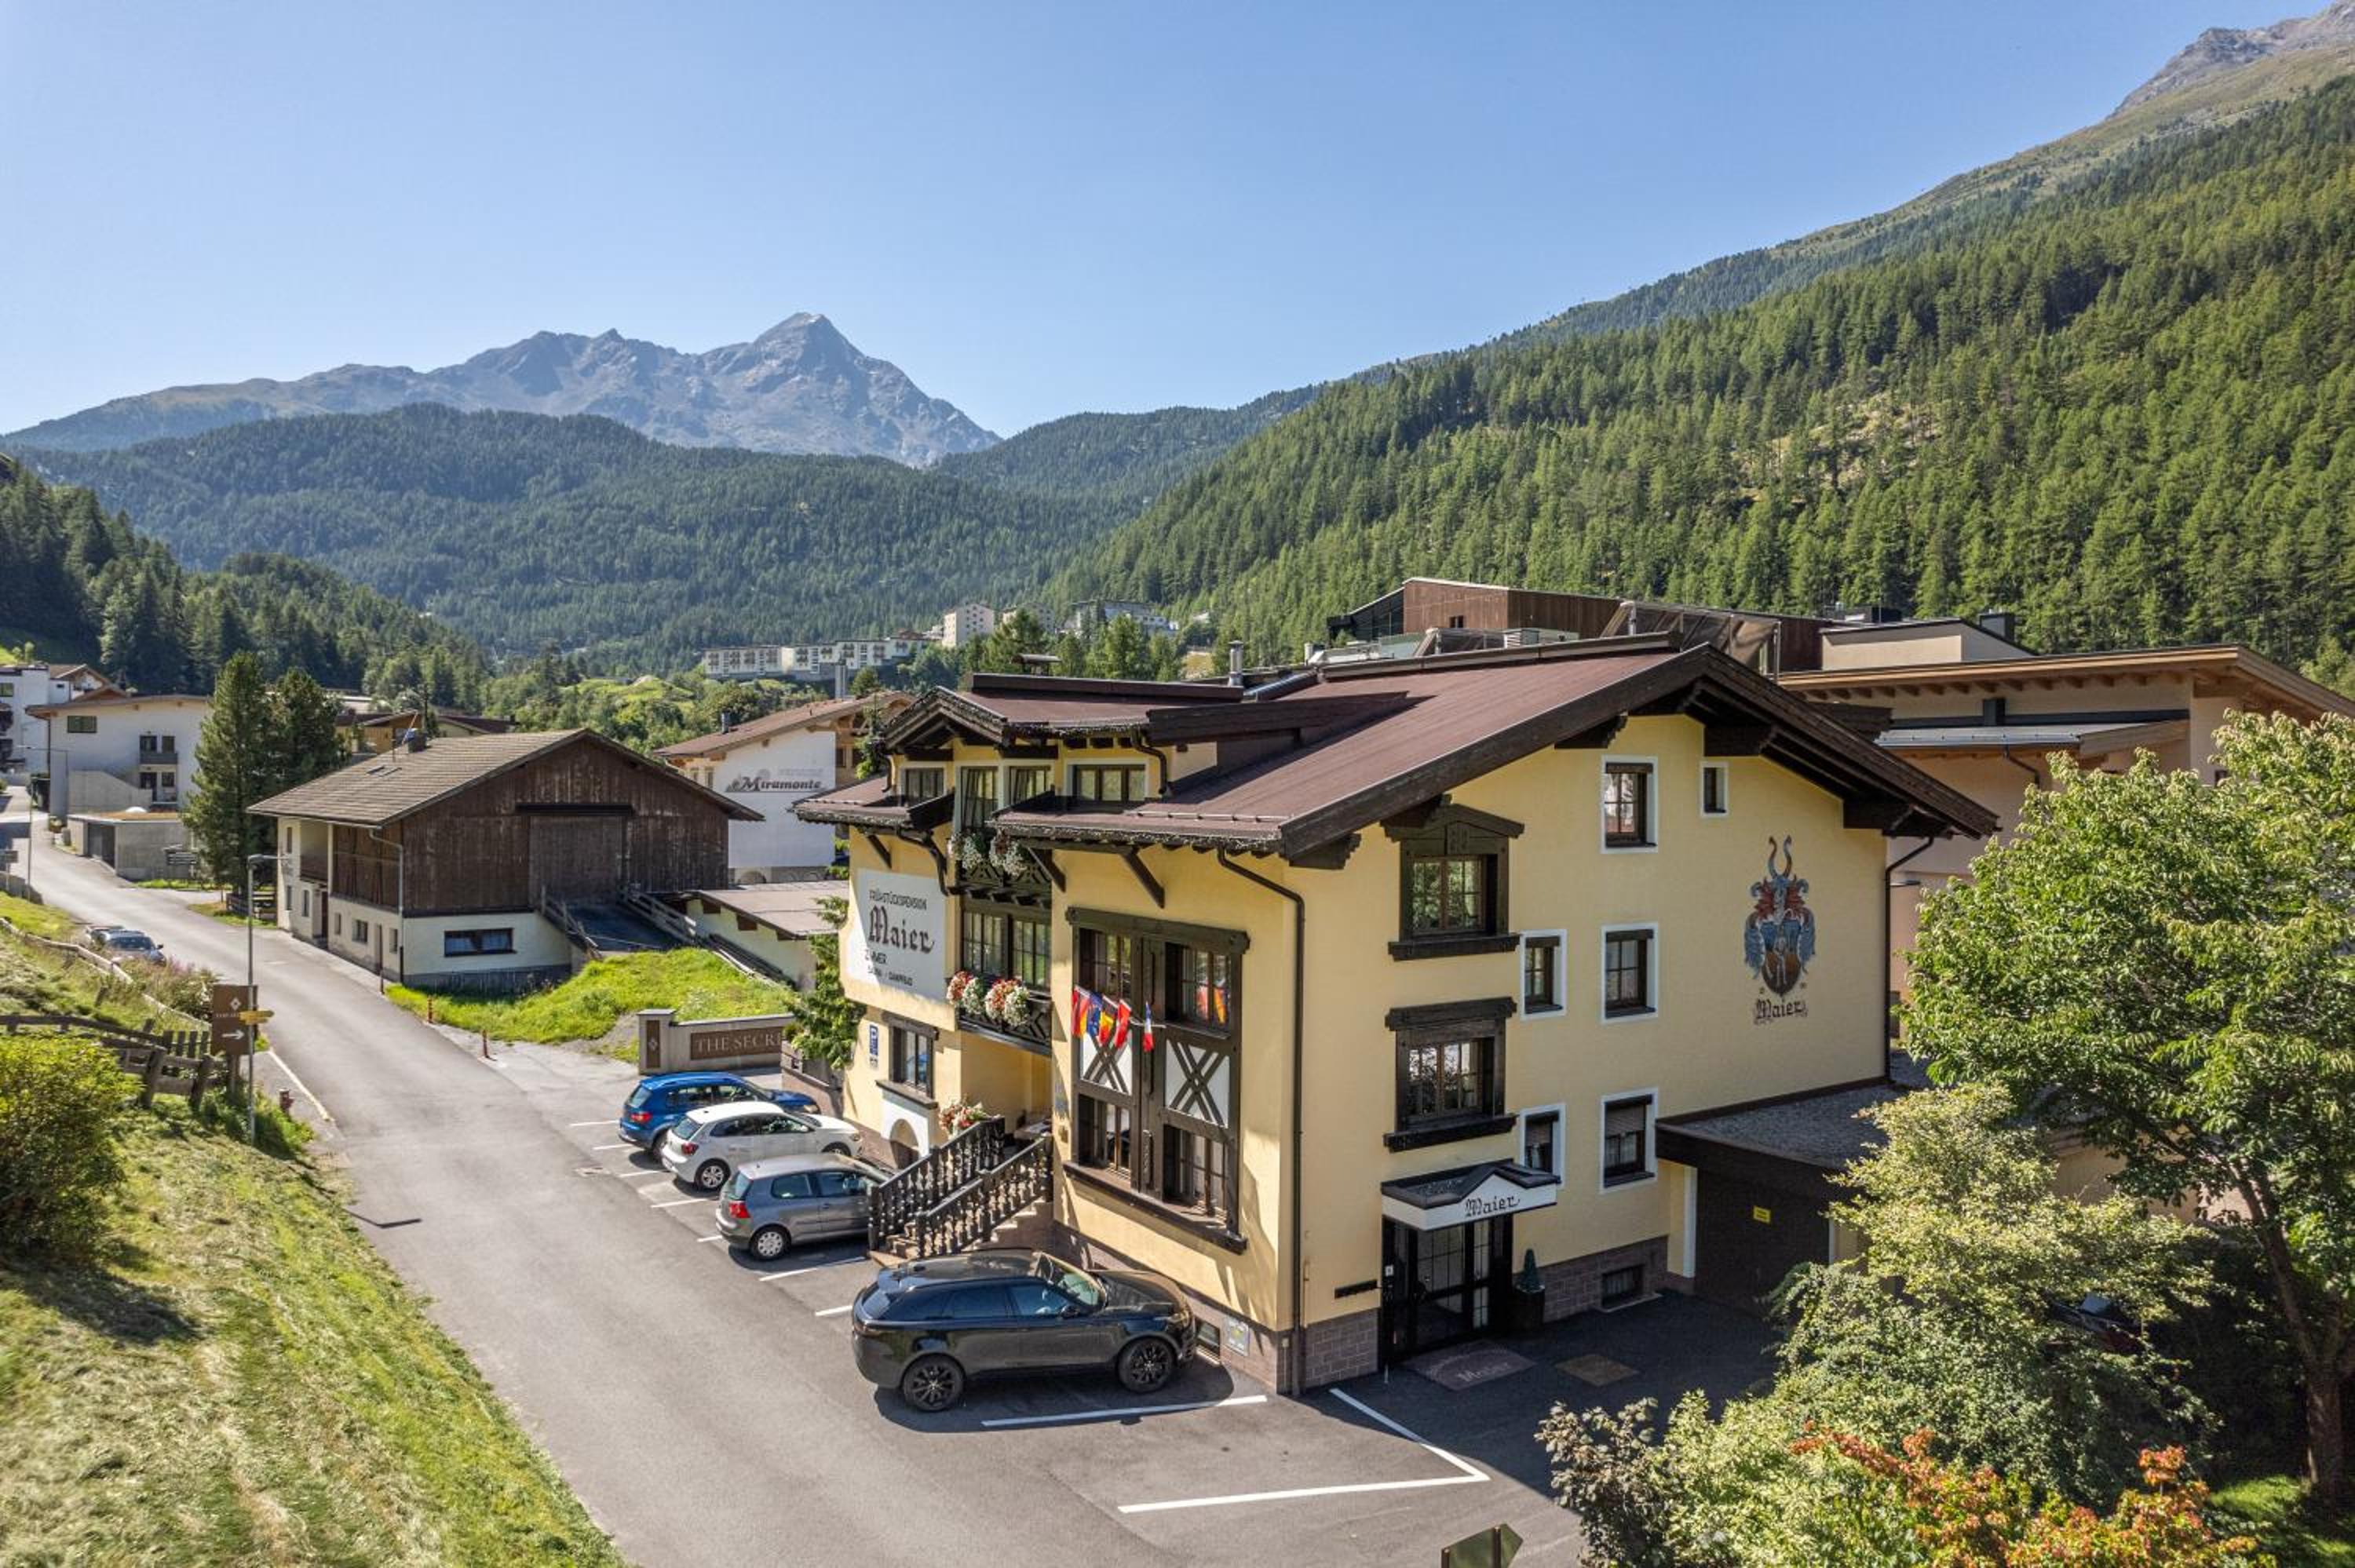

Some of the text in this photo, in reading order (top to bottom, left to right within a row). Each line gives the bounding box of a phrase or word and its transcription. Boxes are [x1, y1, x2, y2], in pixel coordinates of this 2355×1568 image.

[732, 775, 822, 792] Miramonte
[868, 904, 934, 954] Maier
[1754, 997, 1809, 1025] Maier
[696, 1036, 729, 1052] THE
[1465, 1195, 1520, 1218] Maier
